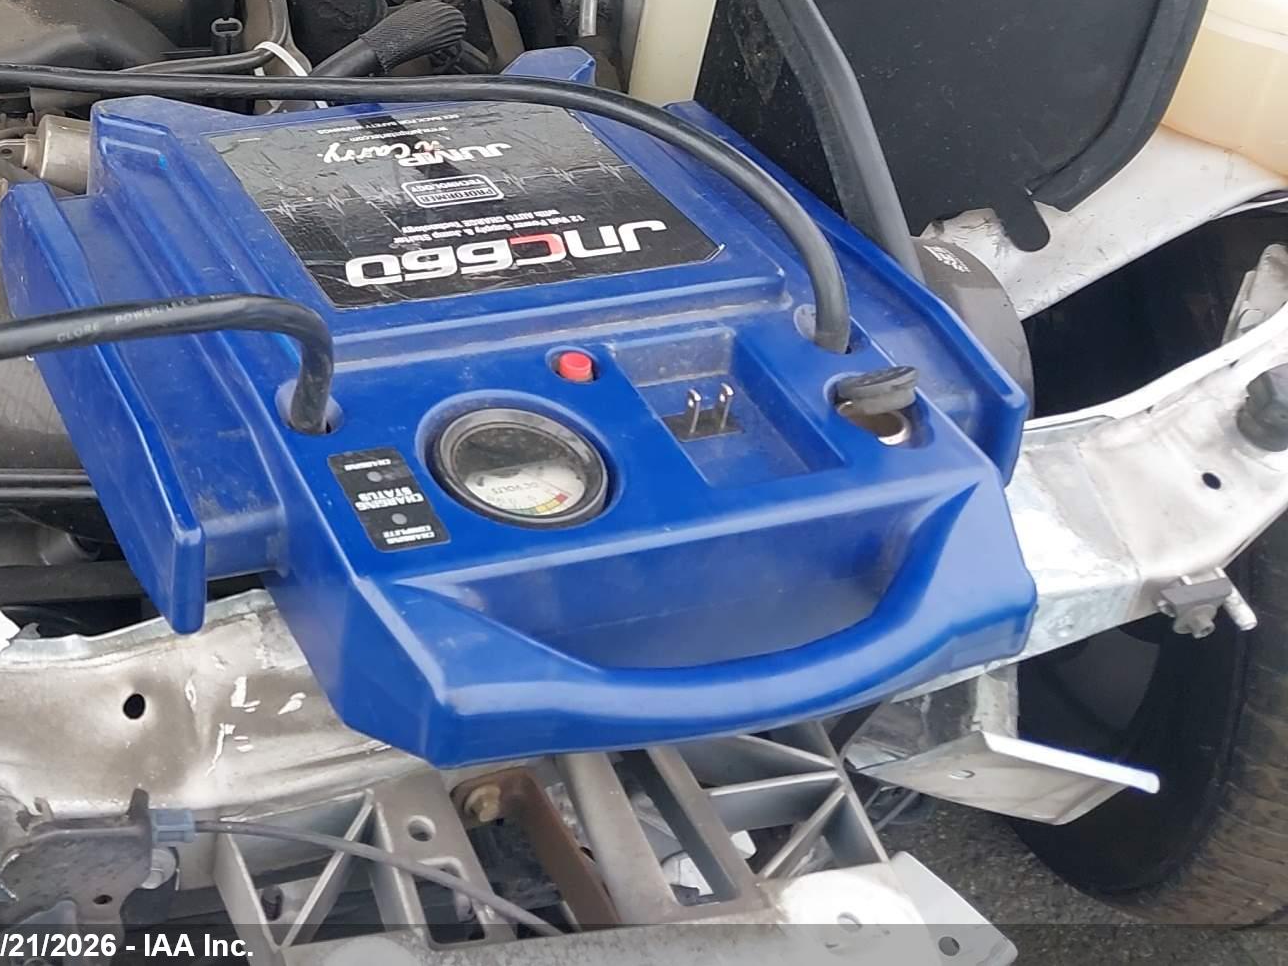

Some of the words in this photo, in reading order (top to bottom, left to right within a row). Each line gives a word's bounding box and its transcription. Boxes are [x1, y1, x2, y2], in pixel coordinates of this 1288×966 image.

[397, 142, 512, 167] JUMP
[411, 178, 486, 192] TECHNOLOGY
[419, 187, 495, 203] PROFORMER
[461, 216, 506, 227] CHARGE
[505, 212, 535, 221] AUTO
[568, 214, 586, 222] 12
[401, 221, 464, 233] Technology
[474, 223, 513, 234] Supply
[513, 219, 549, 228] Power
[431, 230, 463, 238] Jump
[344, 458, 392, 471] CHARGING
[357, 486, 413, 503] STATUS
[354, 492, 425, 512] CHARGING
[382, 525, 432, 539] COMPLETE
[385, 531, 435, 545] CHARGING
